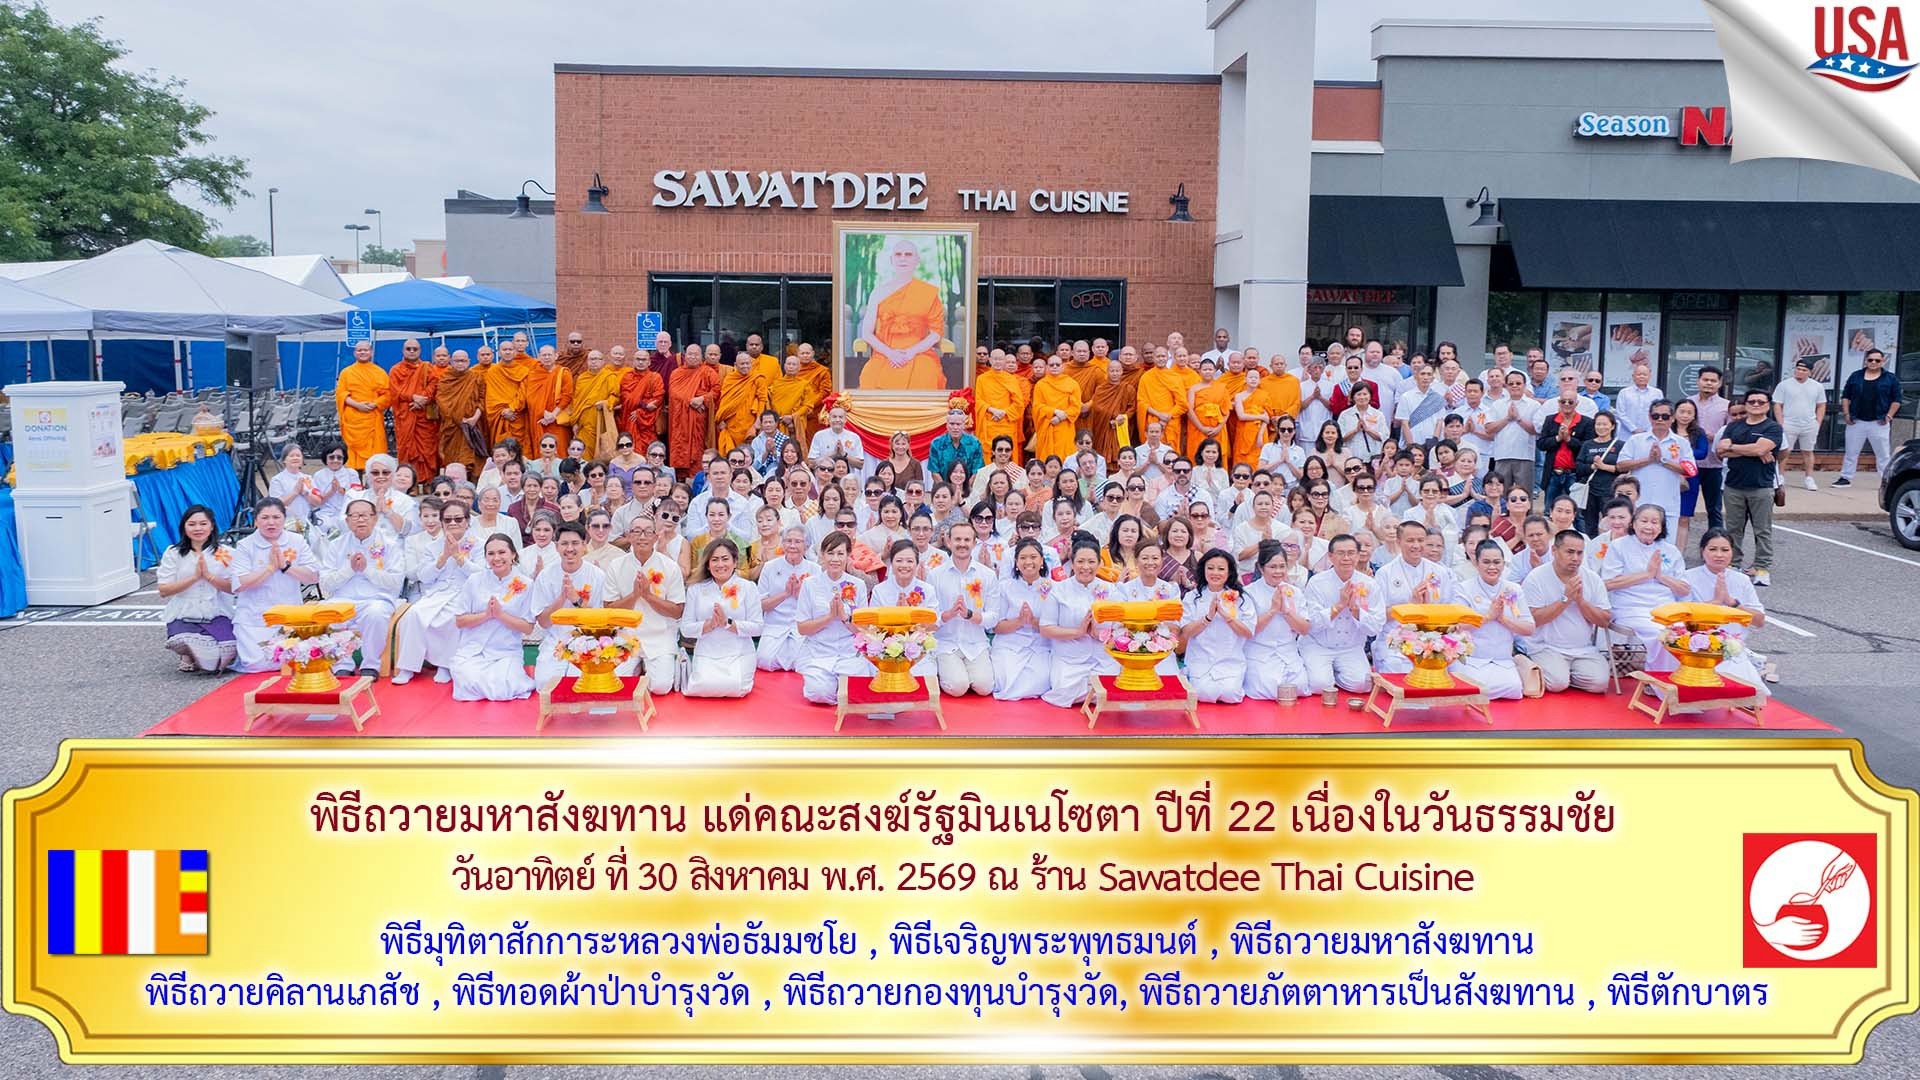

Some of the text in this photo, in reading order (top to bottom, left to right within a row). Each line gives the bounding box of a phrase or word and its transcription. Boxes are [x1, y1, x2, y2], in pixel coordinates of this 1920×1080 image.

[1580, 106, 1733, 147] Season N
[652, 169, 1130, 214] SAWATDEE THAI CUISINE
[1071, 292, 1111, 309] OPEN
[24, 424, 68, 432] DONATION
